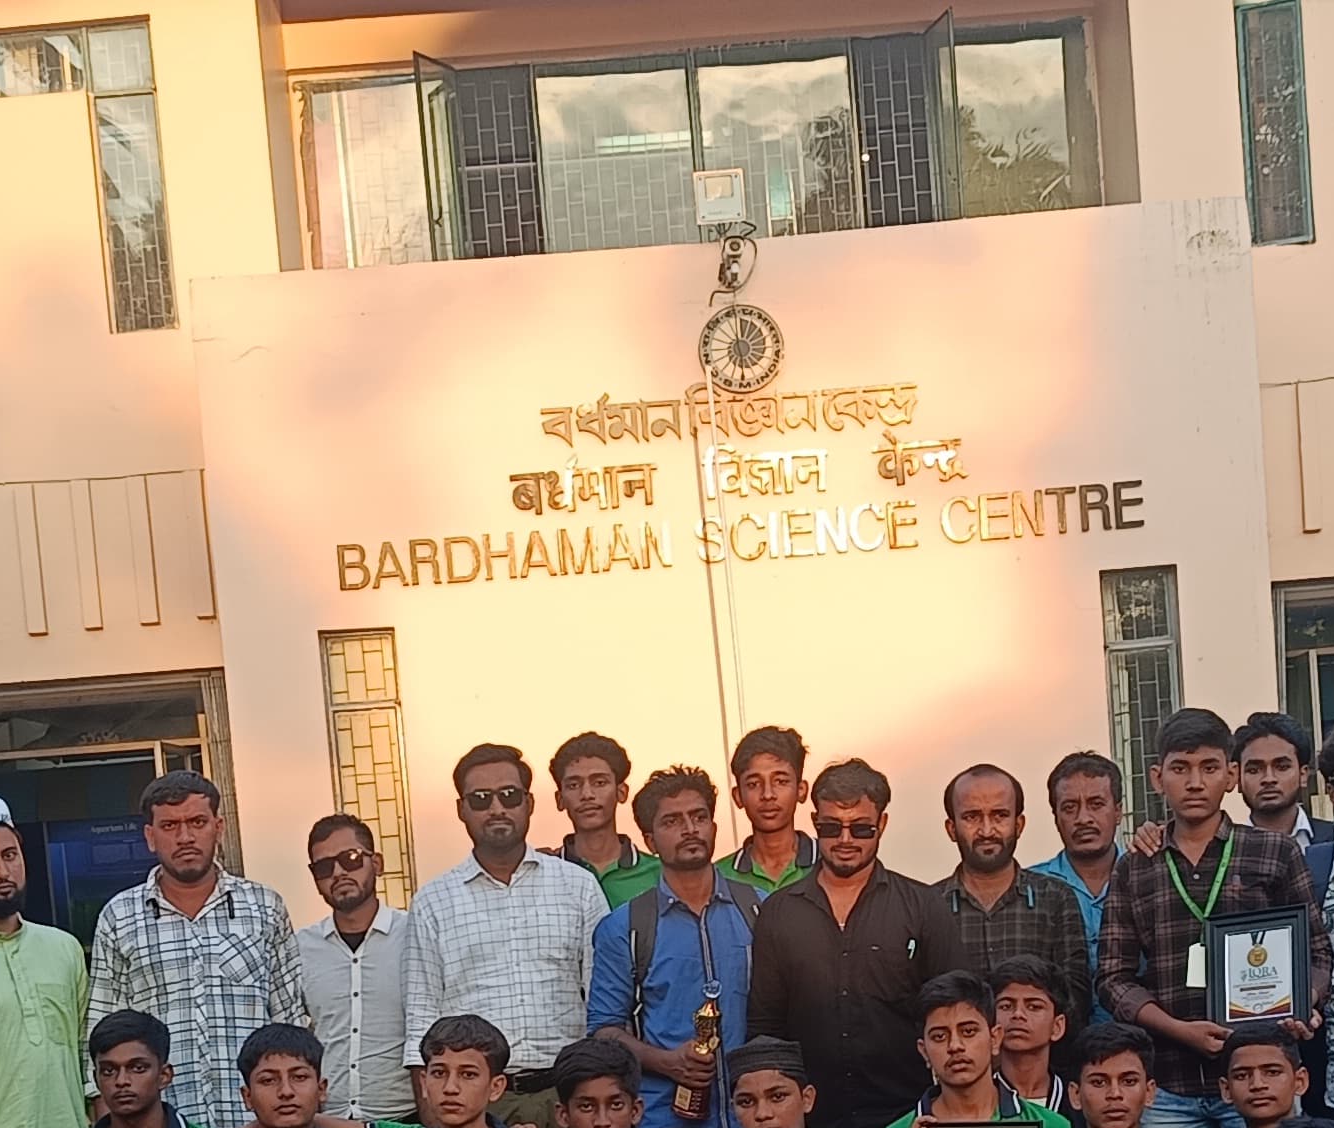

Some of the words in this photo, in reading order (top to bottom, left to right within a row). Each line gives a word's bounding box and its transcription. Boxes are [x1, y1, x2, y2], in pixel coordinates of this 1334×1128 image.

[540, 392, 682, 448] বর্ধমান
[702, 443, 828, 500] विज्ञान
[872, 429, 969, 486] केन्द्र
[336, 521, 673, 591] BARDHAMAN
[693, 500, 919, 564] SCIENCE
[940, 479, 1145, 543] CENTRE
[1248, 966, 1278, 978] IQRA
